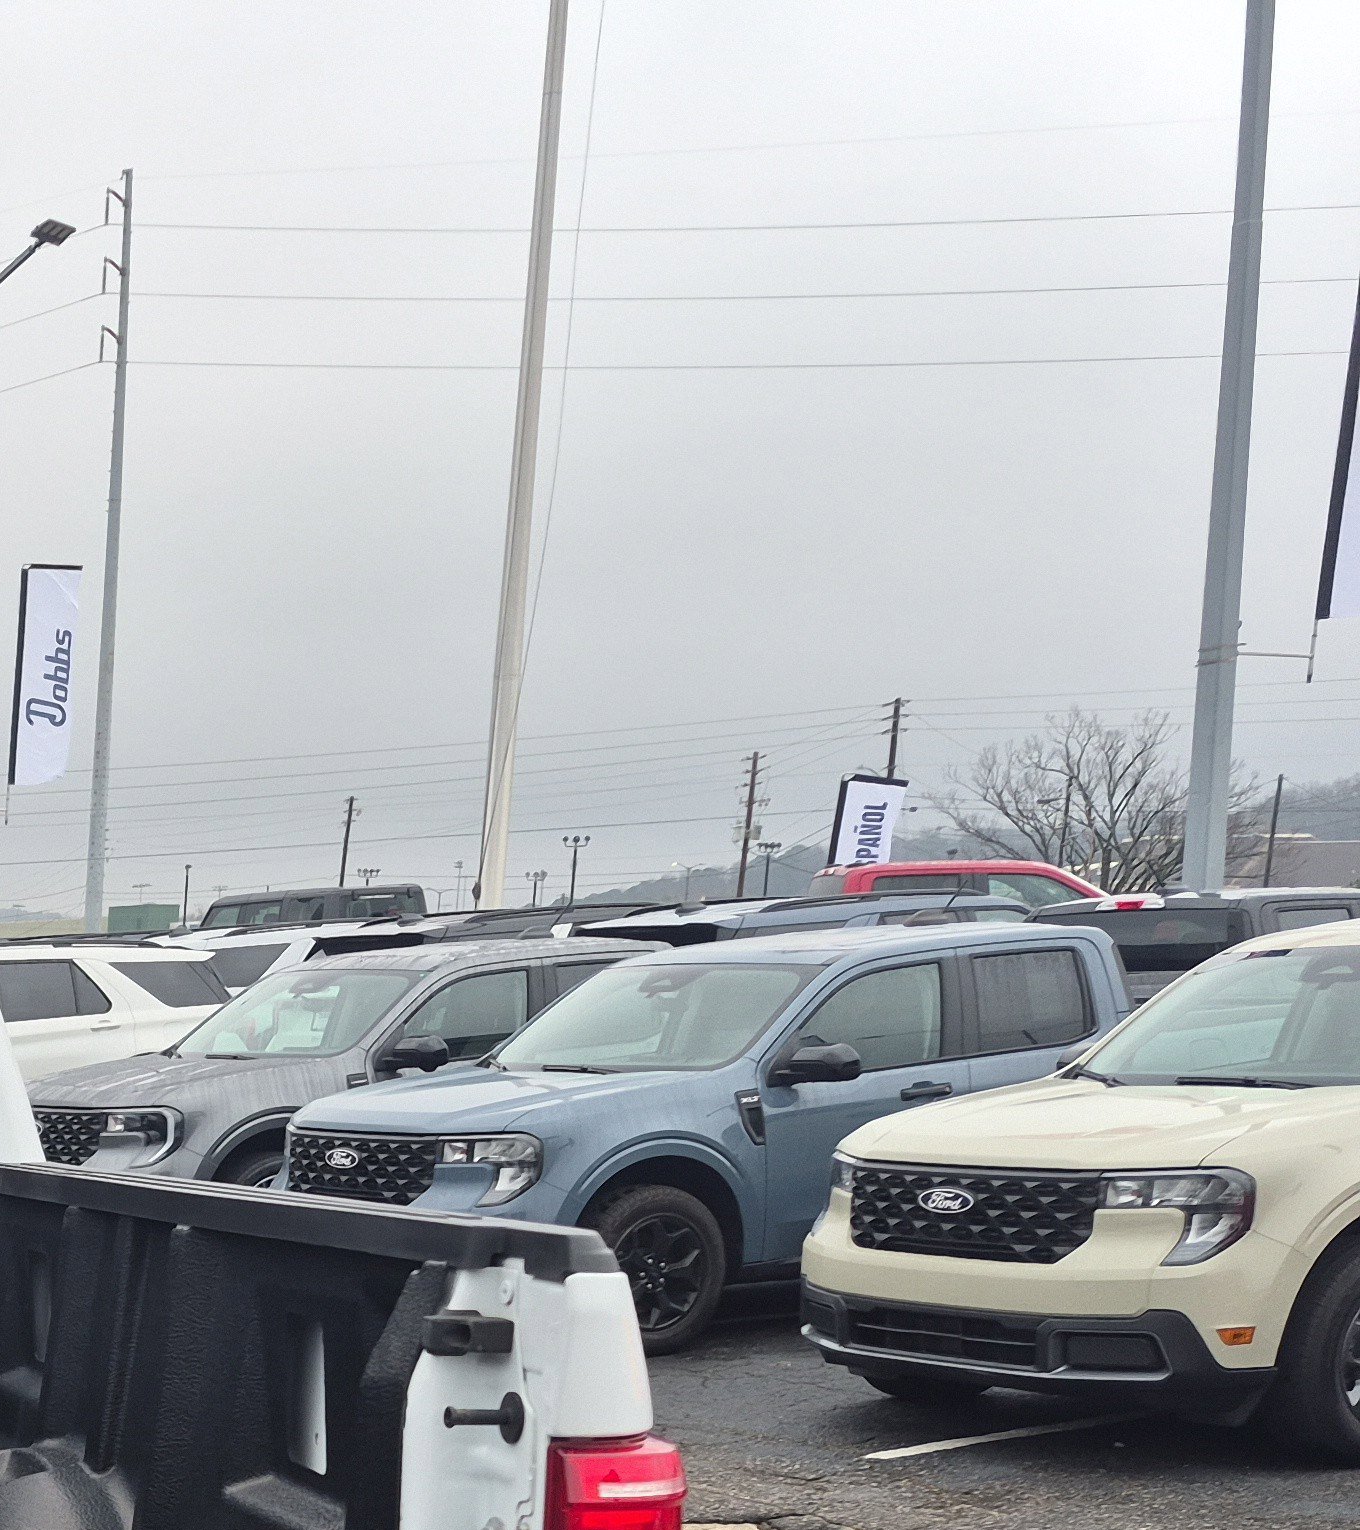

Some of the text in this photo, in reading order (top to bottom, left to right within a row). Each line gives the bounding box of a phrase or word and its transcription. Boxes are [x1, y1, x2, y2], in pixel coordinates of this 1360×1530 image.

[25, 628, 73, 728] Dobbs
[853, 801, 889, 864] PAÑOL
[928, 1191, 964, 1210] Ford
